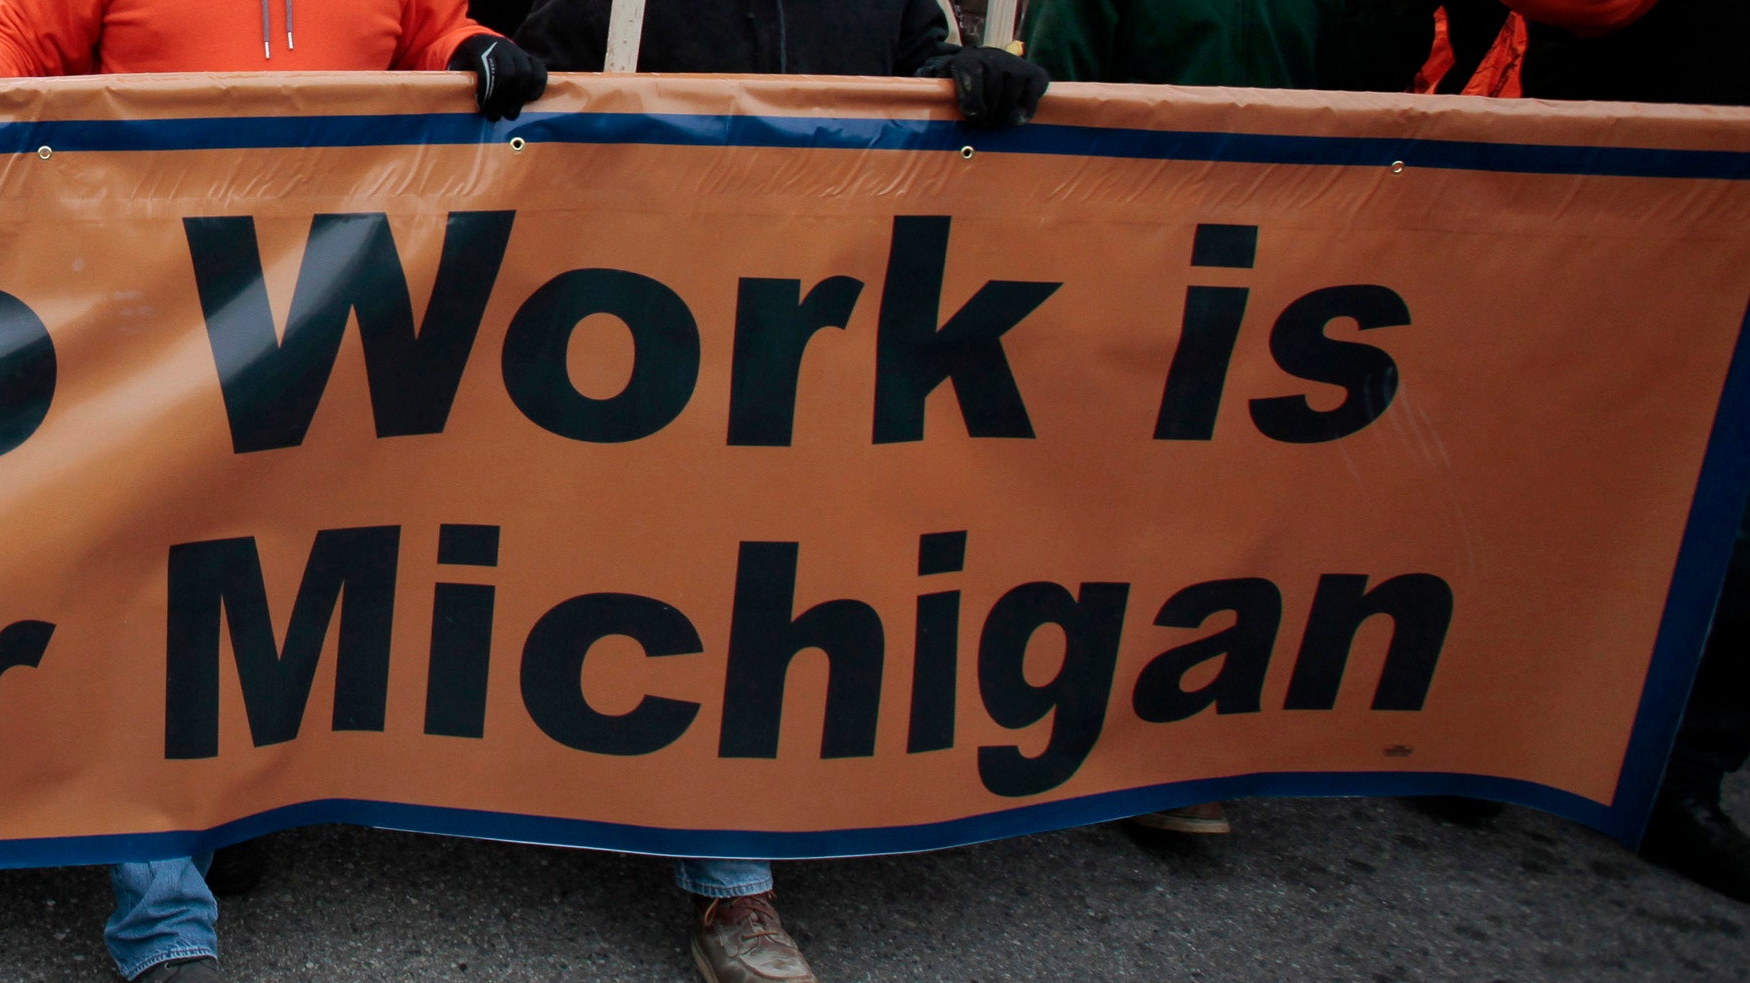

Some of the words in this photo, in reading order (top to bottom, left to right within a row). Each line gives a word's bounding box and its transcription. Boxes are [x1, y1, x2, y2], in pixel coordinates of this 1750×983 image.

[183, 209, 1063, 455] Work
[1153, 223, 1412, 444] is
[164, 524, 1454, 797] Michigan
